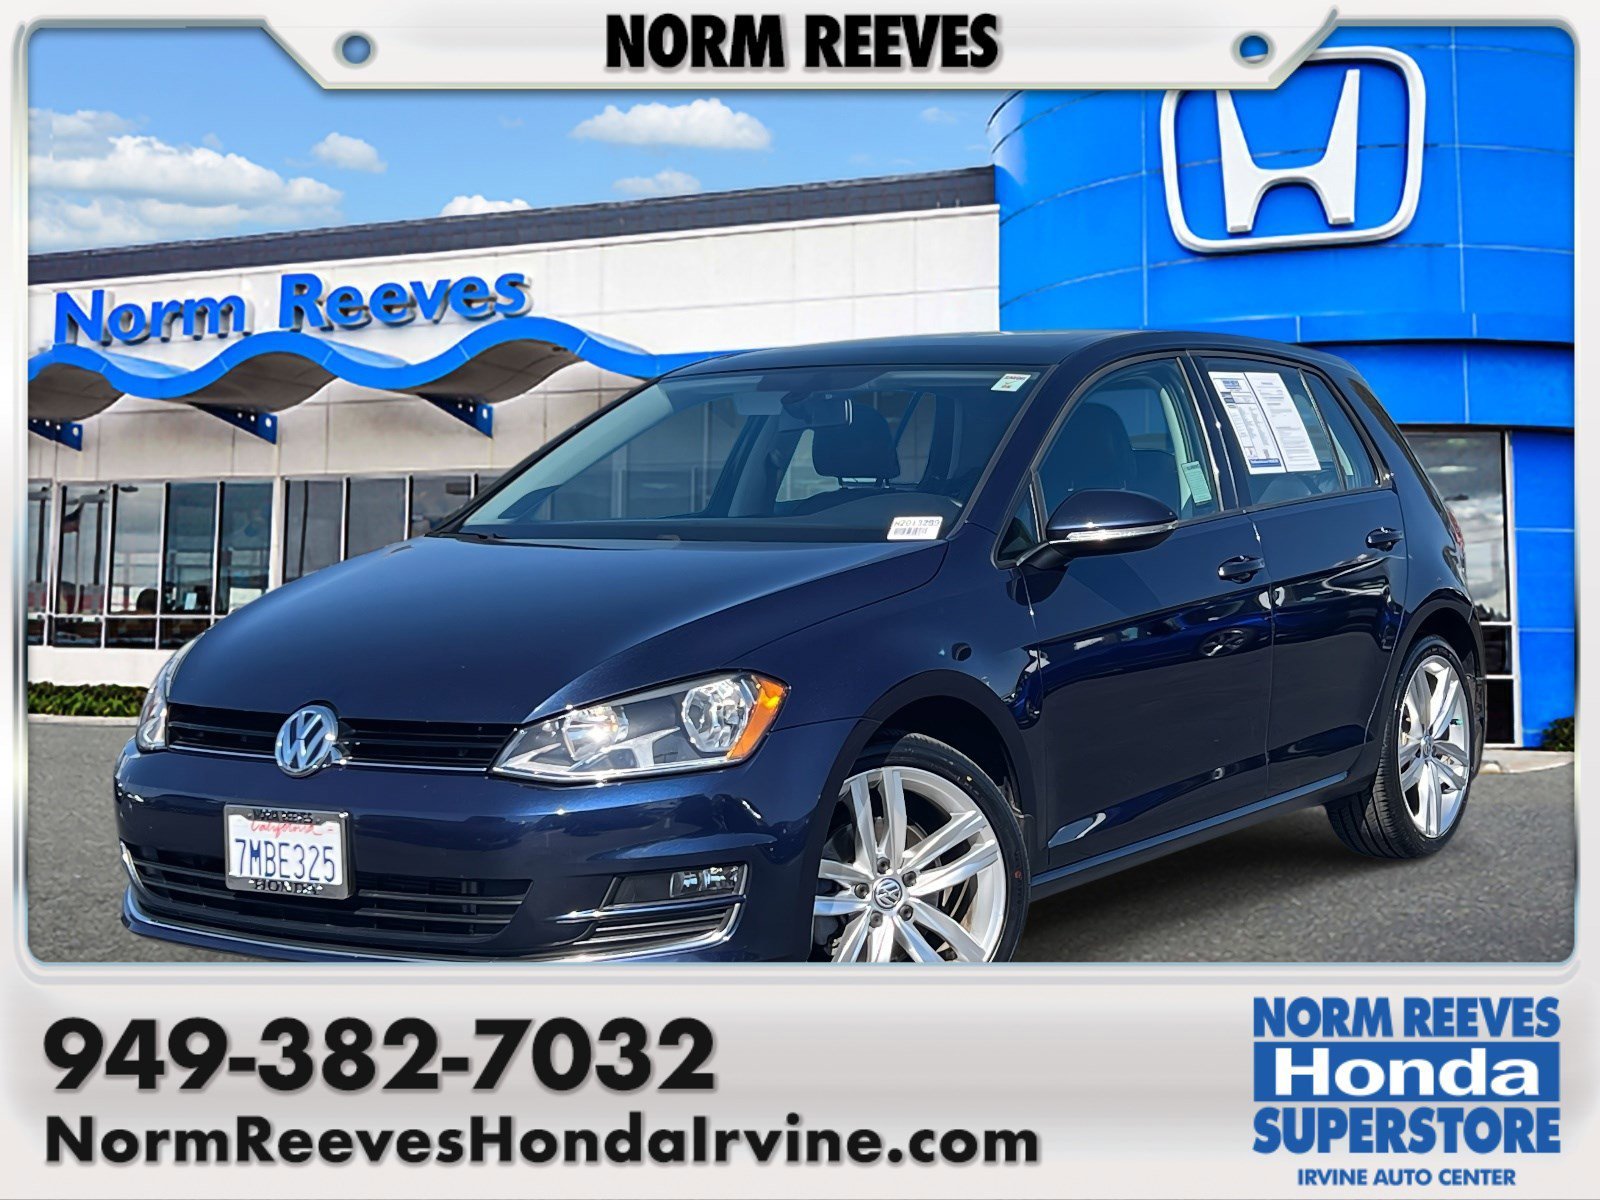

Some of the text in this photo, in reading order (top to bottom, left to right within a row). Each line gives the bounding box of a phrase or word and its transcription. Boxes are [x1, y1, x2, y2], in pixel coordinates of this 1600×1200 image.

[54, 272, 528, 346] Norm Reeves
[234, 838, 335, 883] 7MBE325
